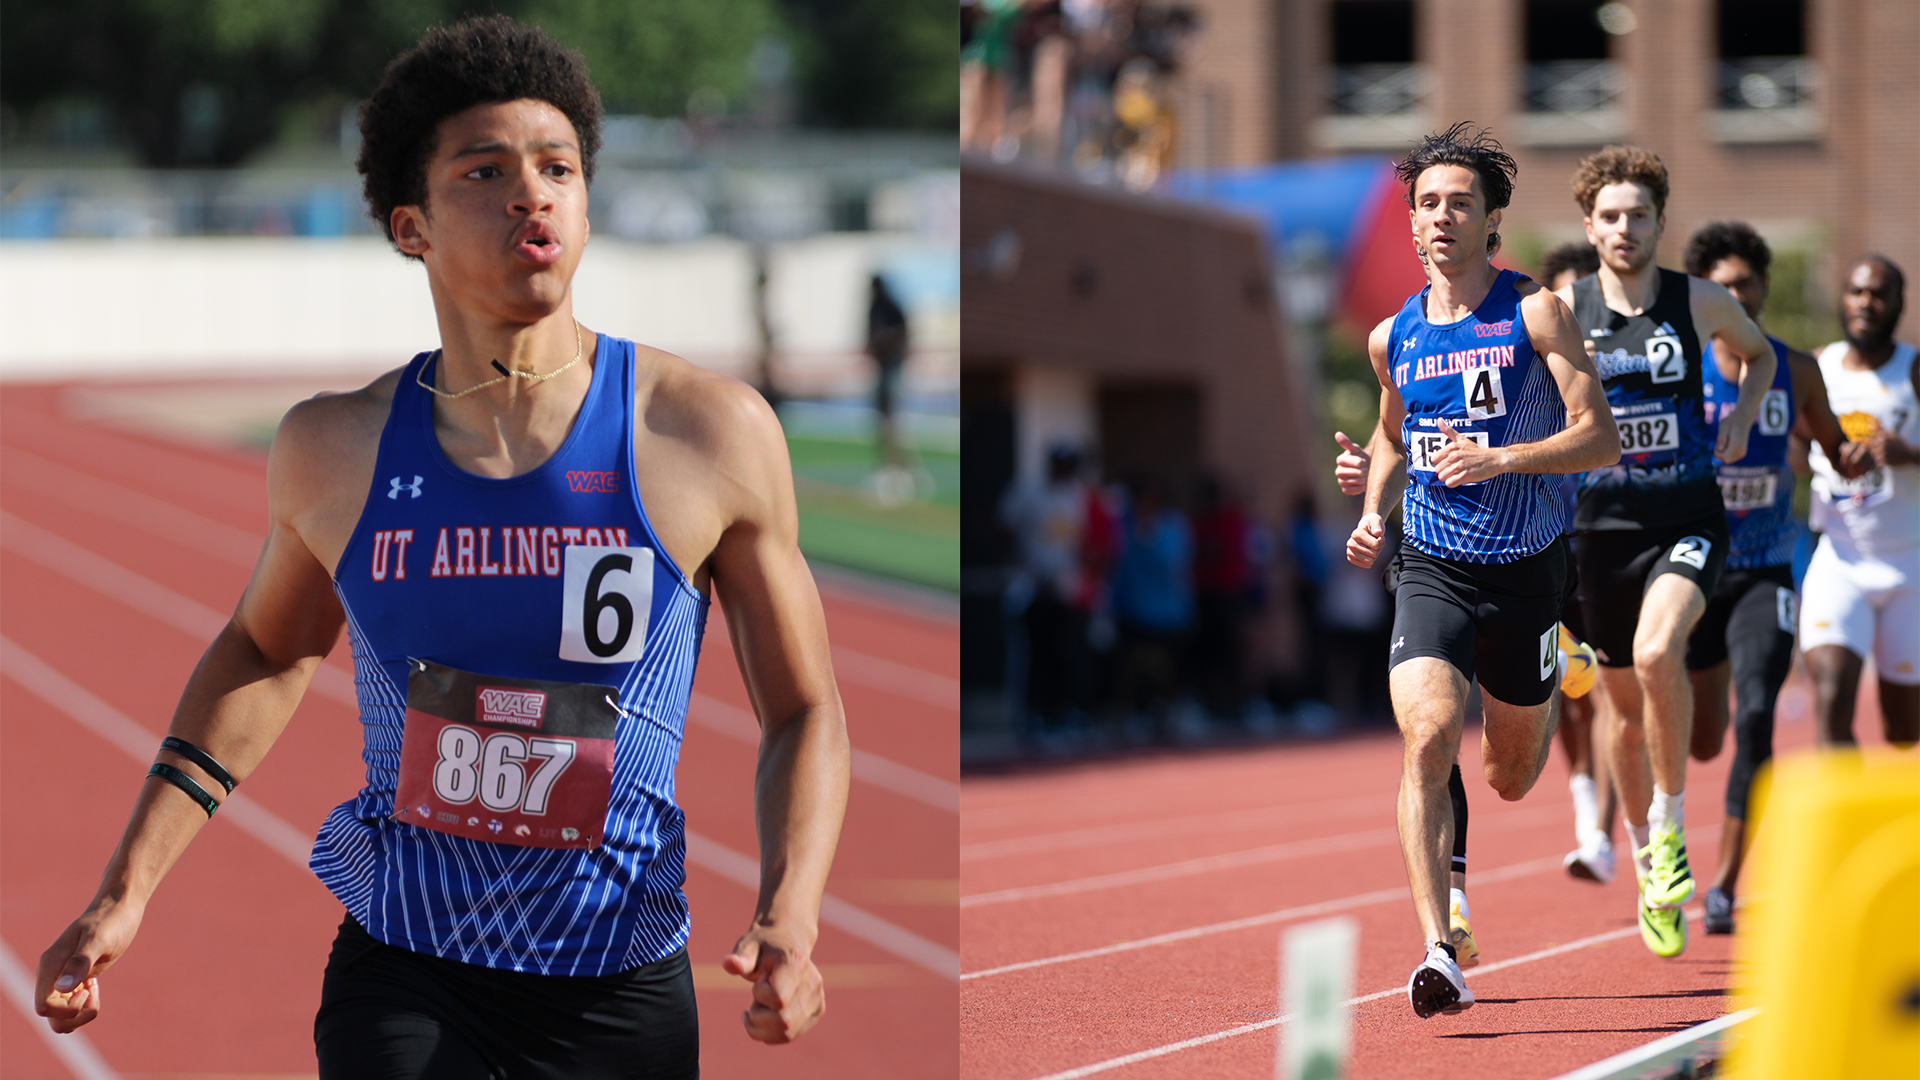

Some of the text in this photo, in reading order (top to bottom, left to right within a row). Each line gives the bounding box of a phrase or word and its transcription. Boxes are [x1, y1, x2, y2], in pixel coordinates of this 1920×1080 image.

[1474, 321, 1512, 337] WAC
[1396, 345, 1515, 388] UT ARLINGTON
[1653, 342, 1678, 378] 2
[1470, 370, 1498, 414] 4
[1418, 418, 1472, 427] SMU NVITE
[1766, 395, 1783, 429] 6
[1418, 436, 1478, 468] 15
[565, 470, 620, 493] WAC
[371, 528, 415, 582] UT
[1679, 540, 1702, 563] 2
[583, 553, 634, 658] 6
[1543, 629, 1554, 670] 4
[479, 688, 545, 718] WAC
[483, 713, 537, 727] CHAMPIONSHIPS
[433, 724, 577, 816] 867
[436, 811, 459, 825] CBU
